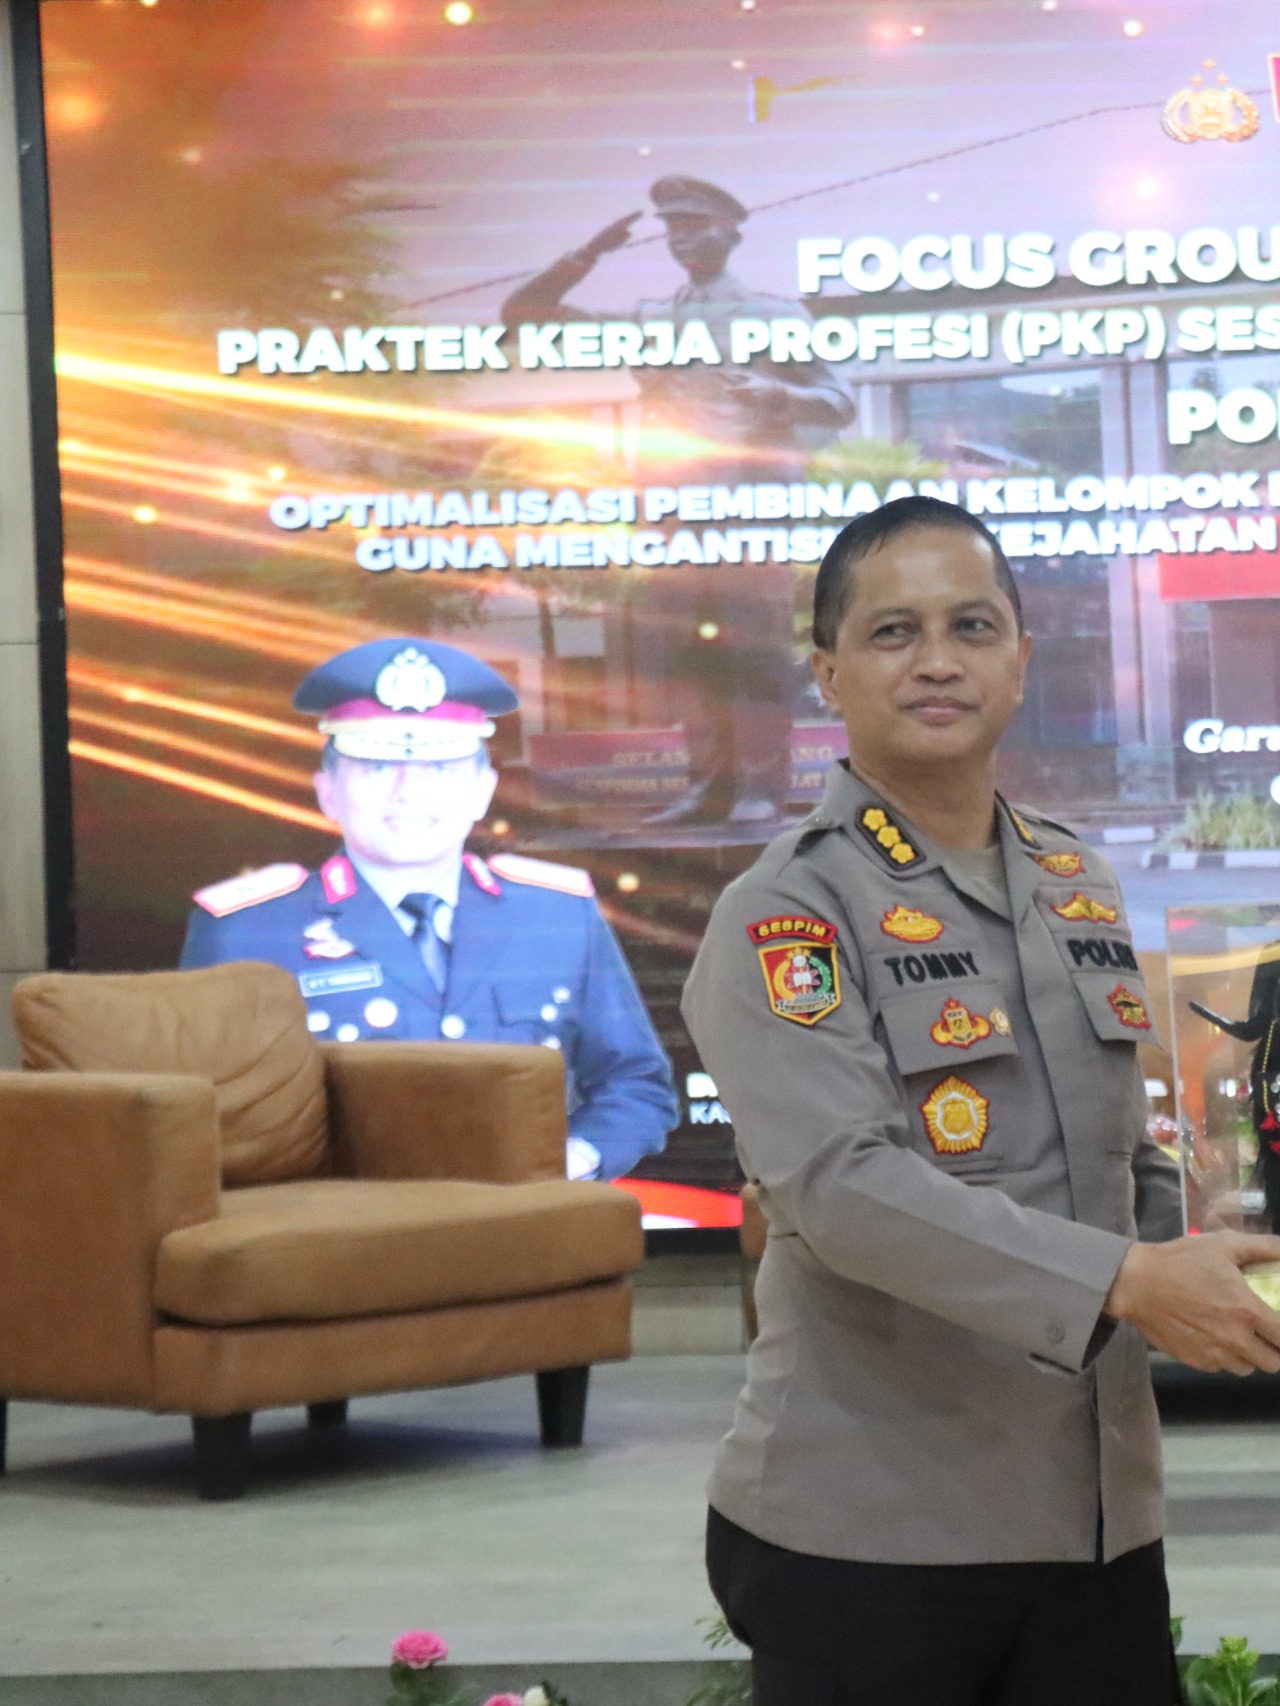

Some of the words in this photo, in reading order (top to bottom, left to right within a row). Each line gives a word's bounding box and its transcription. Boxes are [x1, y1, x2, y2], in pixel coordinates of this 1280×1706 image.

[797, 231, 1055, 296] FOCUS
[217, 324, 508, 375] PRAKTEK
[518, 318, 722, 369] KERJA
[730, 312, 990, 365] PROFESI
[1001, 304, 1168, 364] (PKP)
[270, 487, 637, 531] OPTIMALISASI
[651, 478, 959, 525] PEMBINAAN
[966, 469, 1261, 515] KELOMPOK
[356, 532, 509, 575] GUNA
[988, 513, 1278, 557] EJAHATAN
[758, 919, 827, 937] SESPIM
[884, 949, 981, 987] TOMMY
